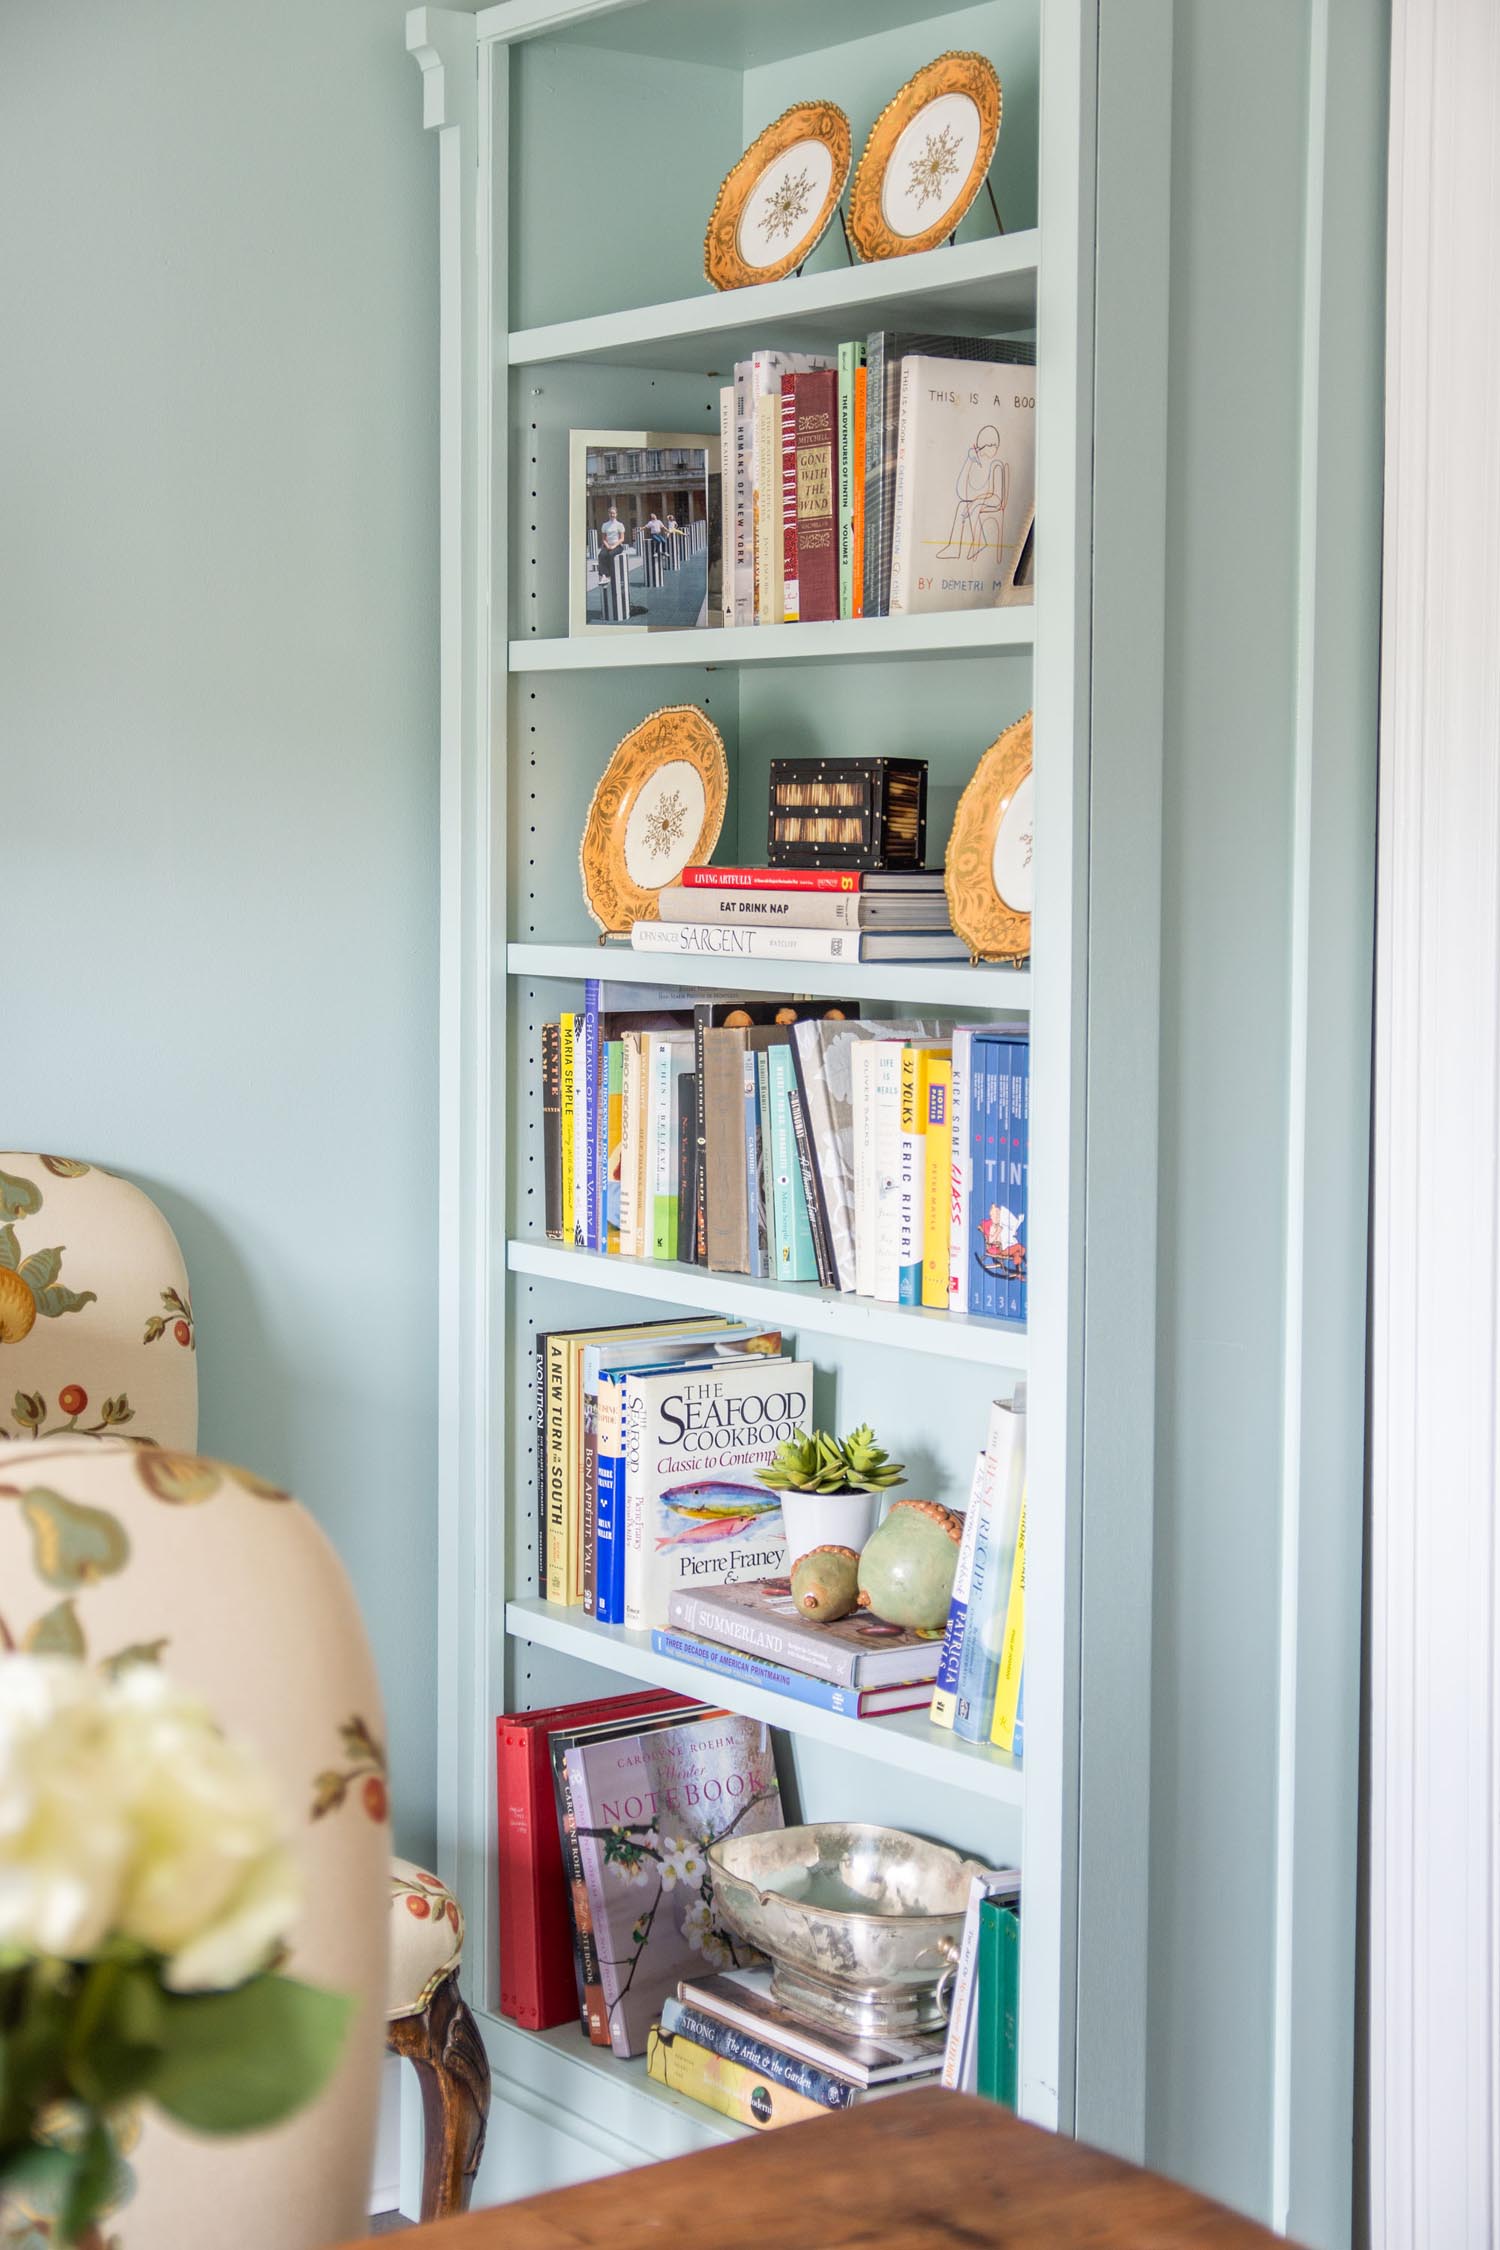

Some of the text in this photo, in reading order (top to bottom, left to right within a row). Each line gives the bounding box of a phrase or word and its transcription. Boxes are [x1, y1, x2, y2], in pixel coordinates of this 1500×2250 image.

[928, 389, 956, 402] THIS
[969, 394, 979, 405] IS
[993, 395, 1001, 406] A
[781, 393, 796, 454] ORHAN
[800, 452, 828, 467] GONE
[801, 467, 828, 481] WITH
[842, 467, 849, 478] OF
[738, 482, 744, 496] OF
[800, 497, 828, 511] WIND
[805, 483, 825, 497] THE
[918, 577, 934, 591] BY
[941, 578, 984, 592] DEMETRI
[694, 873, 718, 885] LIVING
[718, 874, 753, 886] ARTFULLY
[720, 901, 789, 914] EAT DRINK NAP
[680, 926, 757, 954] SARGENT
[551, 1029, 559, 1096] AUNTIE
[564, 1028, 574, 1116] MARIA SEMPLE
[902, 1059, 914, 1124] 32 YOLKS
[951, 1071, 961, 1106] KICK
[937, 1089, 945, 1121] HOTEL
[748, 1136, 756, 1176] CANDIDE
[902, 1141, 912, 1258] ERIC RIPERT
[974, 1293, 980, 1305] 1
[986, 1295, 993, 1307] 2
[999, 1296, 1005, 1309] 3
[1010, 1298, 1018, 1312] 4
[536, 1353, 544, 1430] EVOLUTION
[551, 1346, 563, 1452] A NEW TURN
[683, 1383, 724, 1401] THE
[628, 1395, 644, 1474] SEAFOOD
[658, 1391, 807, 1446] SEAFOOD
[682, 1420, 806, 1452] COOKBOOK
[585, 1448, 593, 1478] BON
[657, 1456, 702, 1475] Classic
[704, 1452, 717, 1469] to
[551, 1465, 563, 1525] SOUTH
[679, 1549, 786, 1577] Pierre Franey
[972, 1517, 990, 1601] RECIPE
[699, 1610, 783, 1653] SUMMERLAND
[939, 1619, 954, 1670] WELLS
[945, 1610, 967, 1684] PATRICIA
[665, 1637, 683, 1651] THREE
[683, 1643, 710, 1660] DECADES
[710, 1653, 719, 1663] OF
[719, 1655, 750, 1673] AMERICAN
[750, 1665, 791, 1686] PRINTMAKING
[617, 1735, 735, 1769] CAROLYNE ROEHM
[600, 1769, 767, 1825] NOTEBOOK
[564, 1786, 577, 1846] CAROLYNE
[571, 1847, 582, 1888] ROEHM
[580, 1921, 594, 1984] NOTEBOOK
[681, 2016, 716, 2042] STRONG
[726, 2037, 813, 2090] The Artist & the Garden
